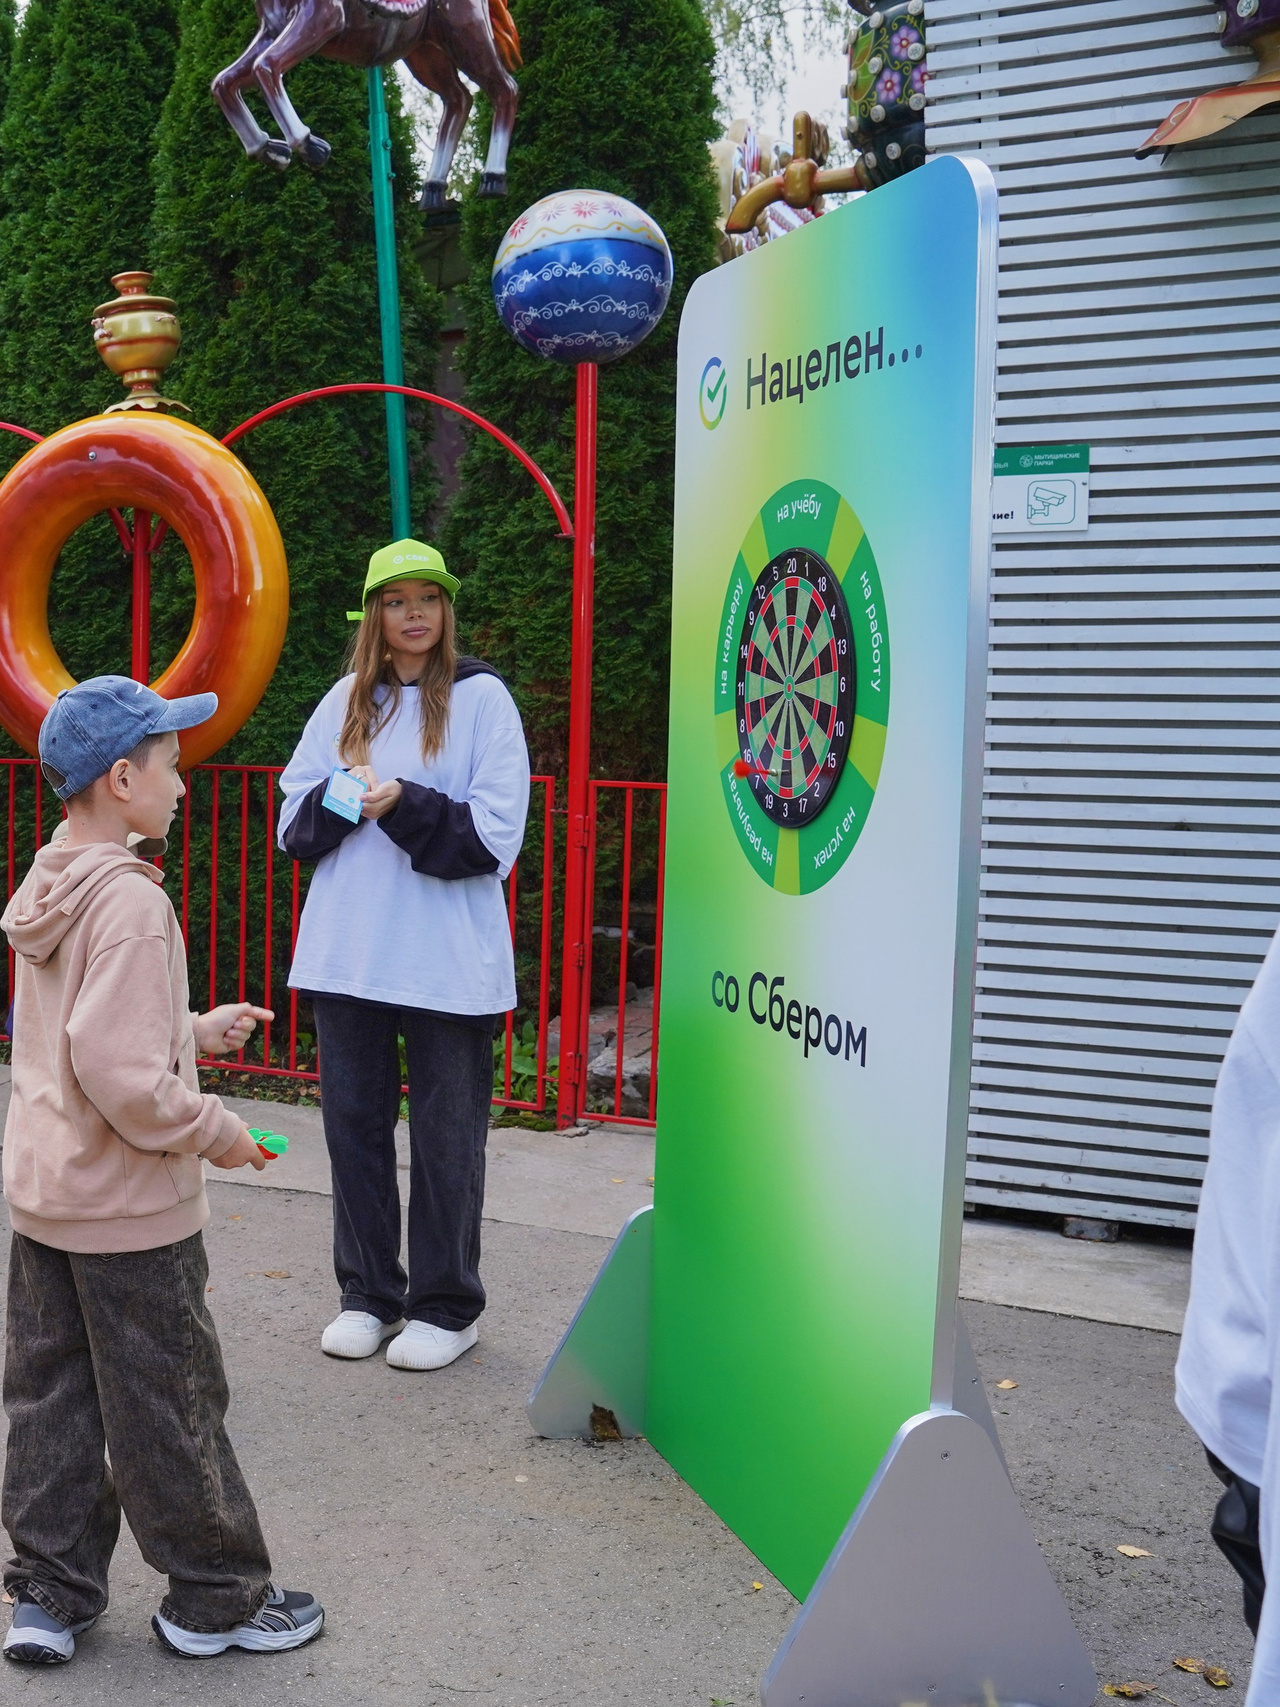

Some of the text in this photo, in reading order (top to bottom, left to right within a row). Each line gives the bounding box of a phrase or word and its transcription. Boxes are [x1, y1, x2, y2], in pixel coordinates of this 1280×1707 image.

[746, 326, 923, 410] Нацелен...
[777, 493, 822, 523] на учёбу
[772, 566, 779, 581] 5
[786, 557, 797, 574] 20
[804, 562, 809, 577] 1
[755, 585, 766, 600] 12
[817, 577, 827, 592] 18
[748, 611, 755, 626] 9
[830, 605, 837, 621] 4
[721, 578, 743, 694] на карьеру
[860, 571, 883, 692] на работу
[740, 645, 749, 659] 14
[837, 639, 847, 655] 13
[737, 681, 745, 696] 11
[840, 676, 846, 693] 6
[739, 718, 746, 733] 8
[835, 721, 844, 737] 10
[743, 748, 751, 764] 16
[826, 752, 836, 768] 15
[754, 775, 760, 789] 7
[814, 781, 820, 797] 2
[765, 794, 774, 809] 19
[798, 798, 808, 813] 17
[782, 802, 788, 818] 3
[727, 772, 773, 866] на результат
[813, 806, 856, 869] на успех
[711, 970, 867, 1068] со Сбером
